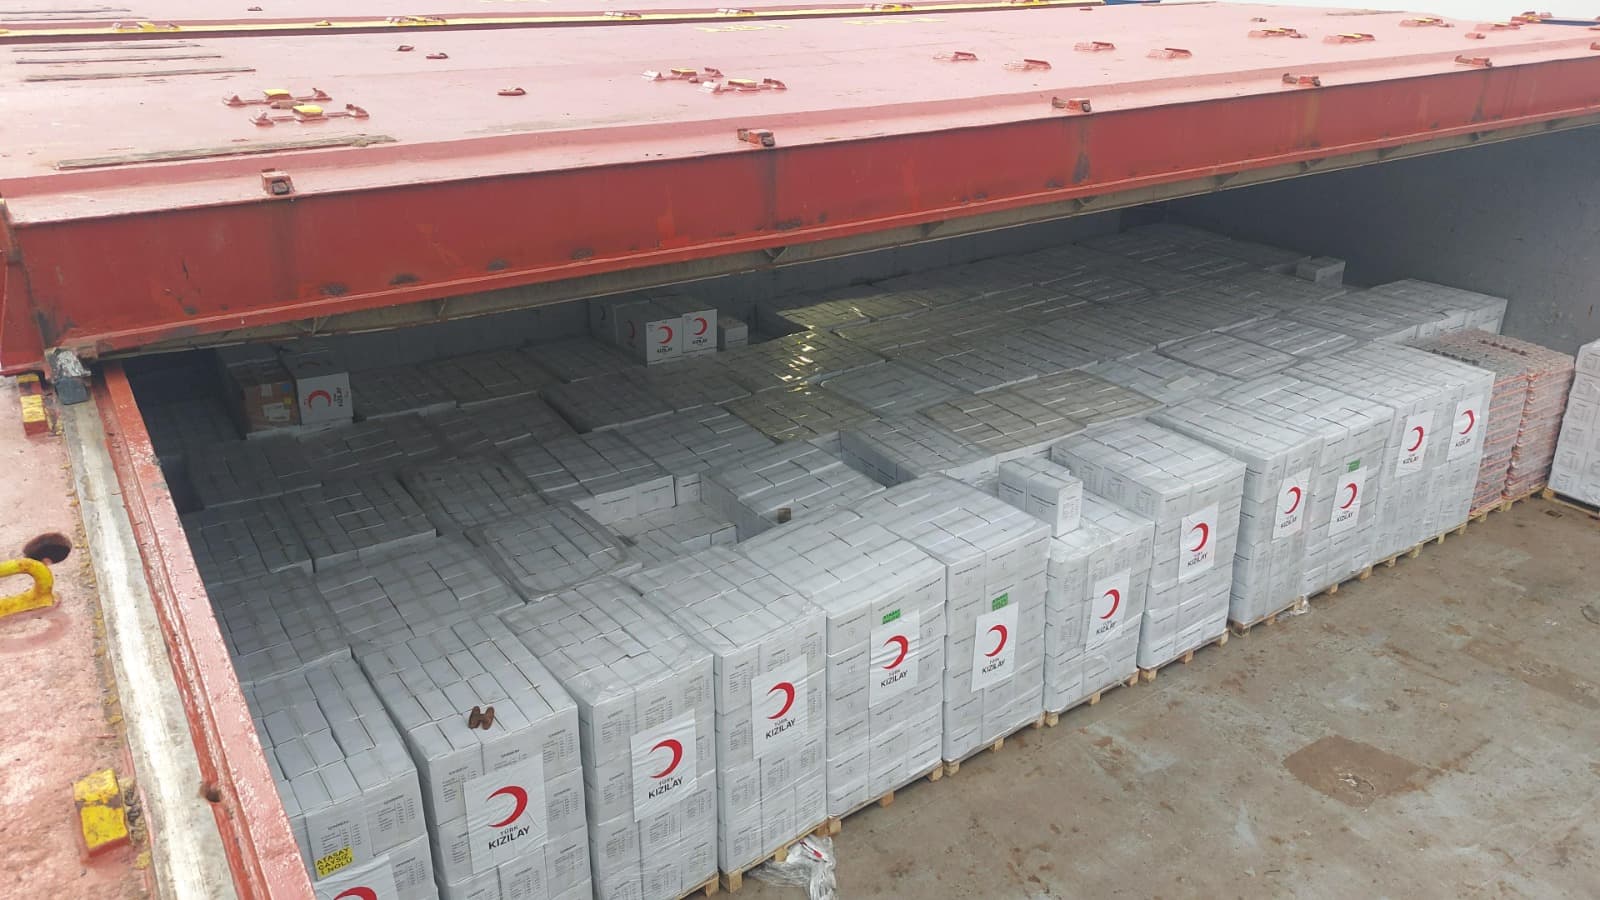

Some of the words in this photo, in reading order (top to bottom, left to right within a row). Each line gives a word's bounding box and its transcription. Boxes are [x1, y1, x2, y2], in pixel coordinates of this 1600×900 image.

[881, 670, 908, 687] KIZILAY
[766, 718, 795, 739] KIZILAY
[648, 776, 683, 799] KIZILAY
[488, 825, 530, 850] KIZILAY
